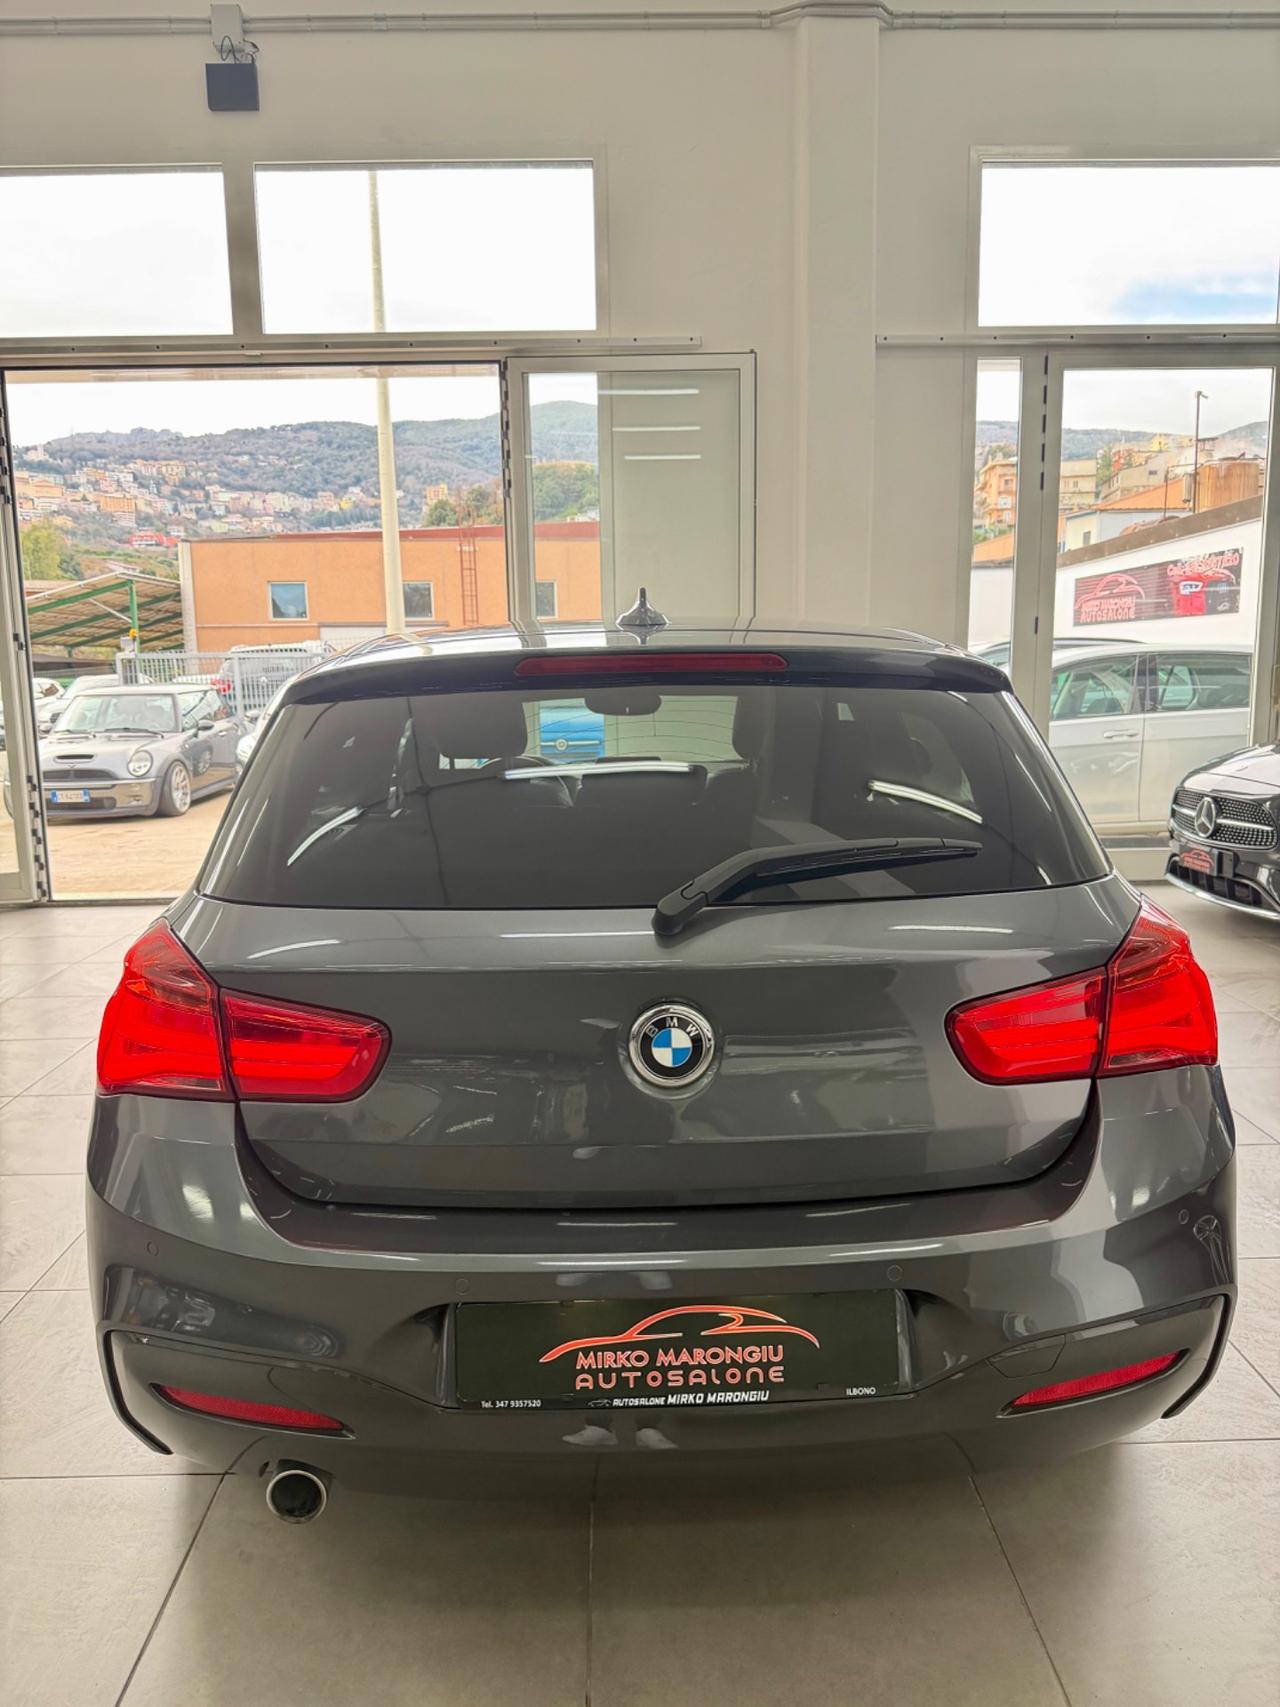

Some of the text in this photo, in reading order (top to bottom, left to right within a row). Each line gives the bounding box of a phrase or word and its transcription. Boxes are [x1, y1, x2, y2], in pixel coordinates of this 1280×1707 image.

[645, 1016, 699, 1038] BMW
[575, 1345, 784, 1370] MIRKO MARONGIU
[575, 1365, 785, 1390] AUTOSALONE
[612, 1390, 770, 1407] AUTOSALONE MIRKO MARONGIU
[846, 1386, 876, 1396] ILBONO
[481, 1399, 542, 1409] Tel. 347 9357520
